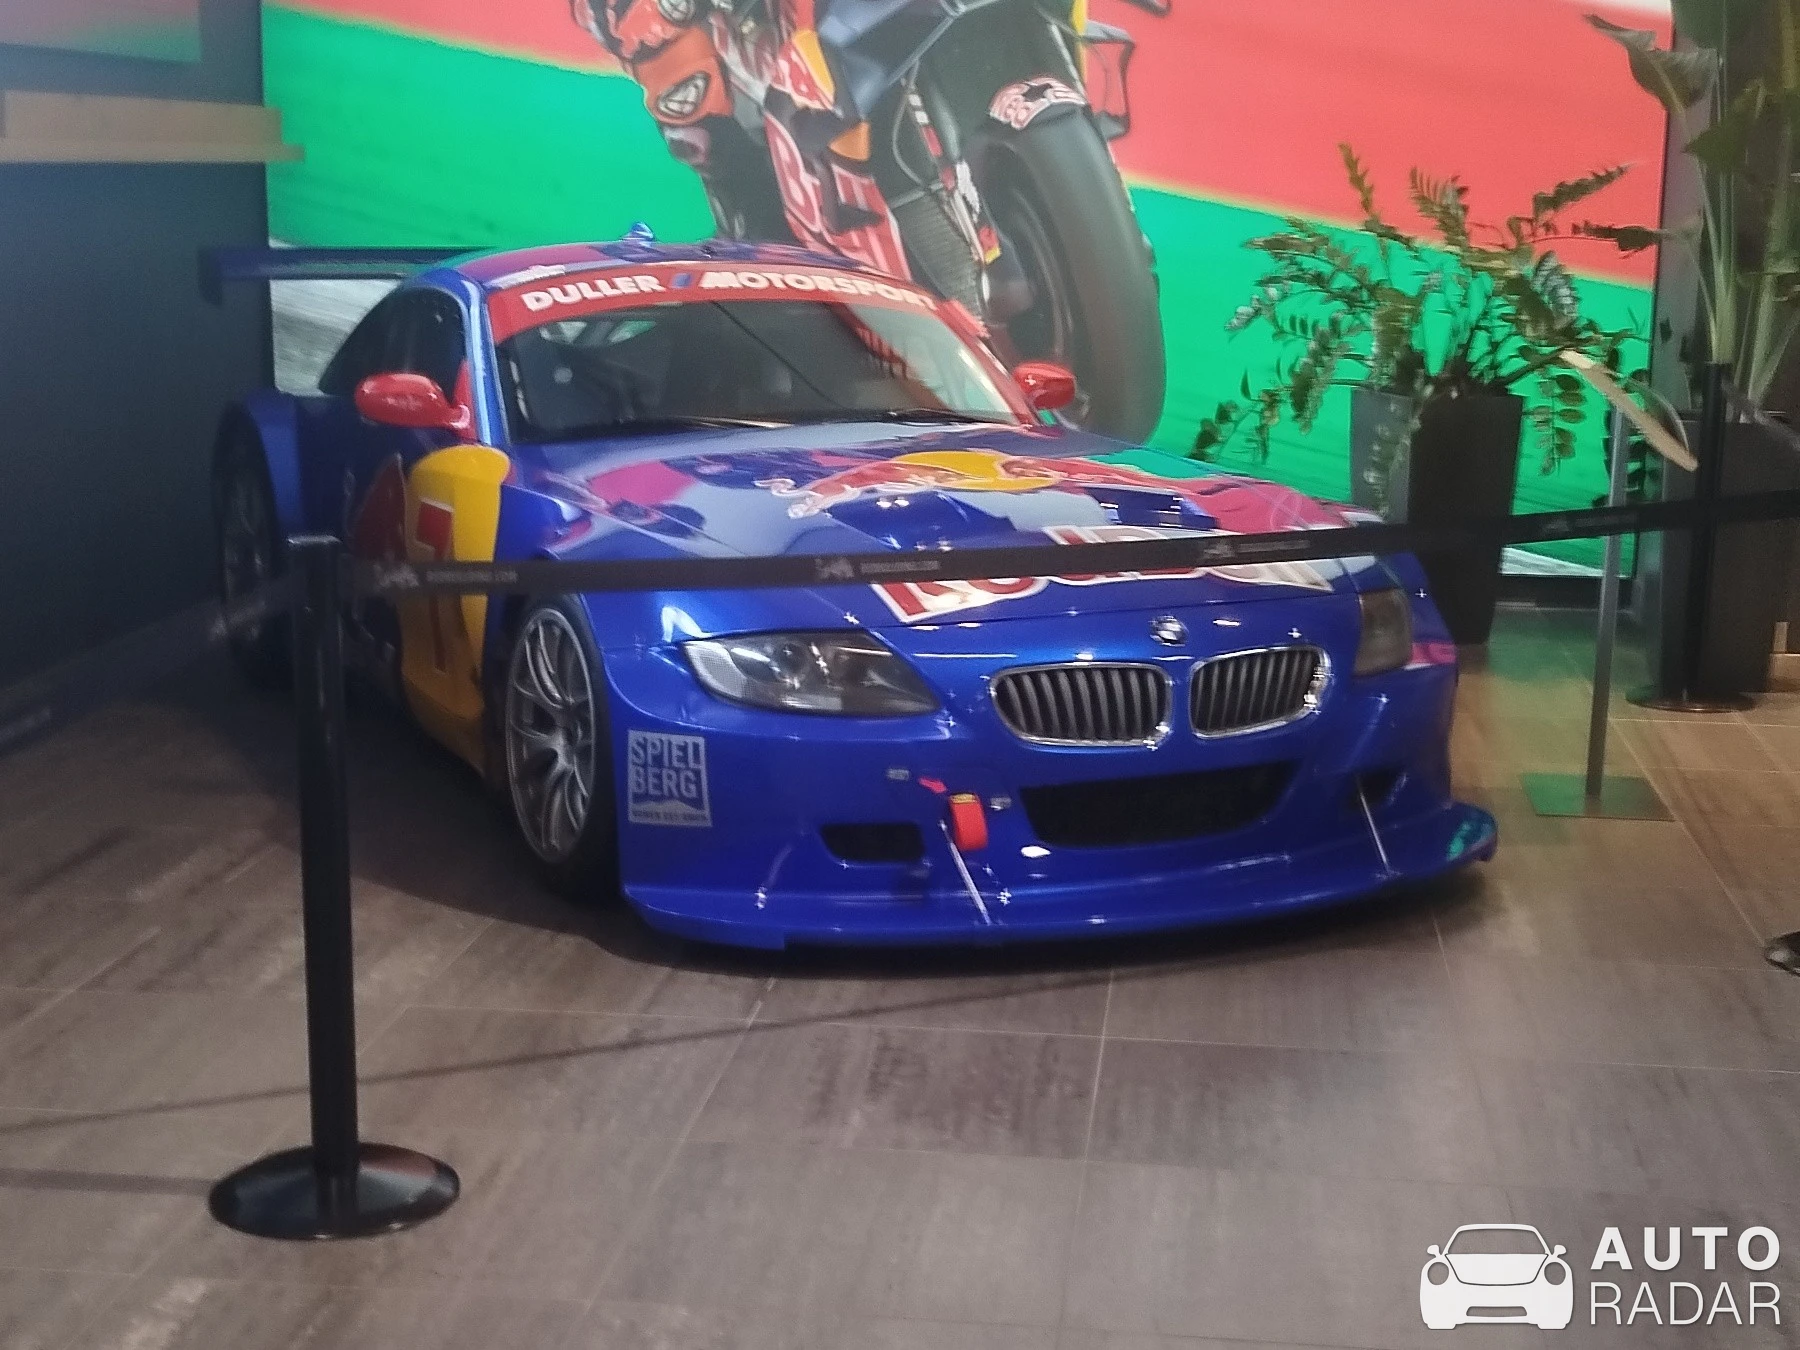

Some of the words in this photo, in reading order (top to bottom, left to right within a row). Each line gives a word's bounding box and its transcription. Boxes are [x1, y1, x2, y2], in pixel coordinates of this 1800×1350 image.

[520, 275, 667, 312] DULLER
[699, 271, 938, 310] MOTORSPORT
[631, 737, 702, 769] SPIEL
[632, 766, 697, 798] BERG
